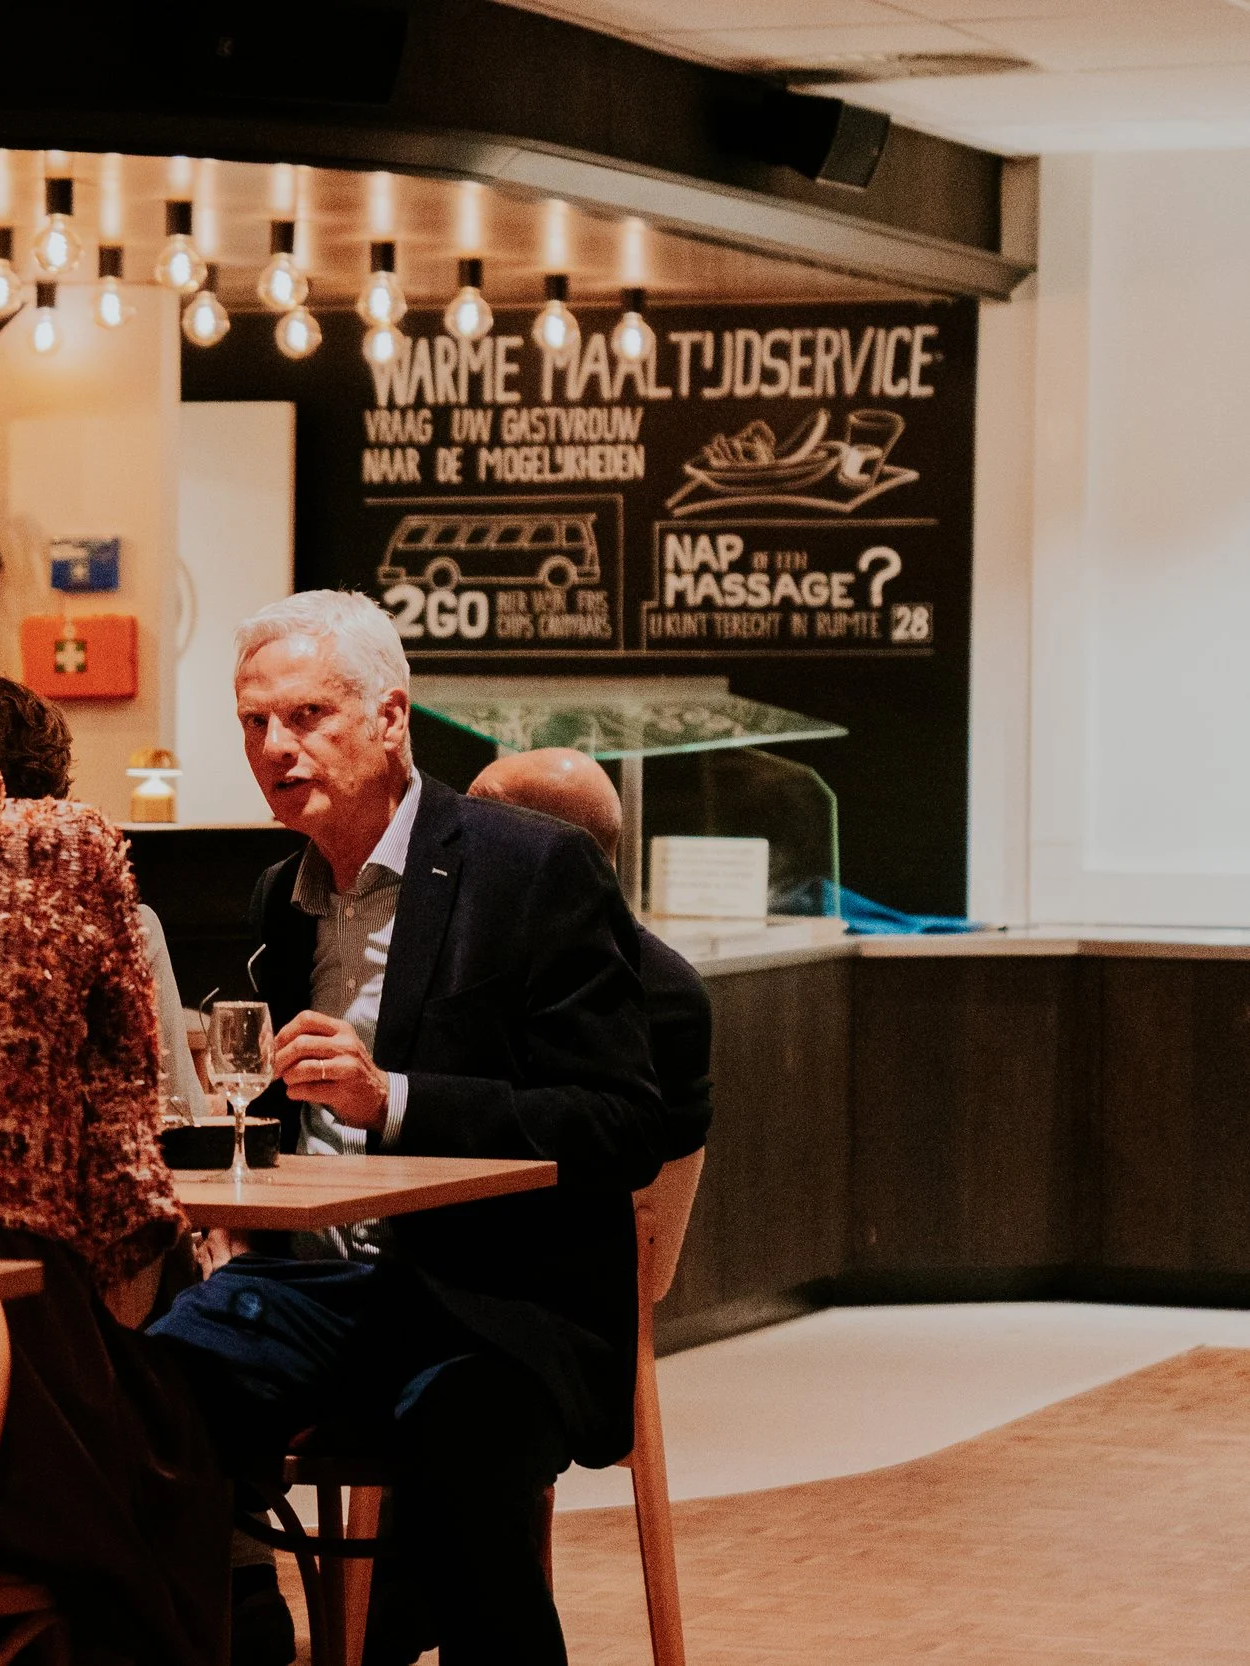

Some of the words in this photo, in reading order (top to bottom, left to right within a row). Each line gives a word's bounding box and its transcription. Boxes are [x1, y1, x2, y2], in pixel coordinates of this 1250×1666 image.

[370, 334, 524, 406] WARME
[364, 408, 433, 444] VRAAG
[452, 408, 494, 444] UW
[362, 448, 421, 484] NAAR
[436, 447, 463, 484] DE
[665, 534, 745, 573] NAP
[664, 572, 856, 608] MASSAGE
[384, 584, 490, 640] 2GO
[891, 605, 930, 641] 28
